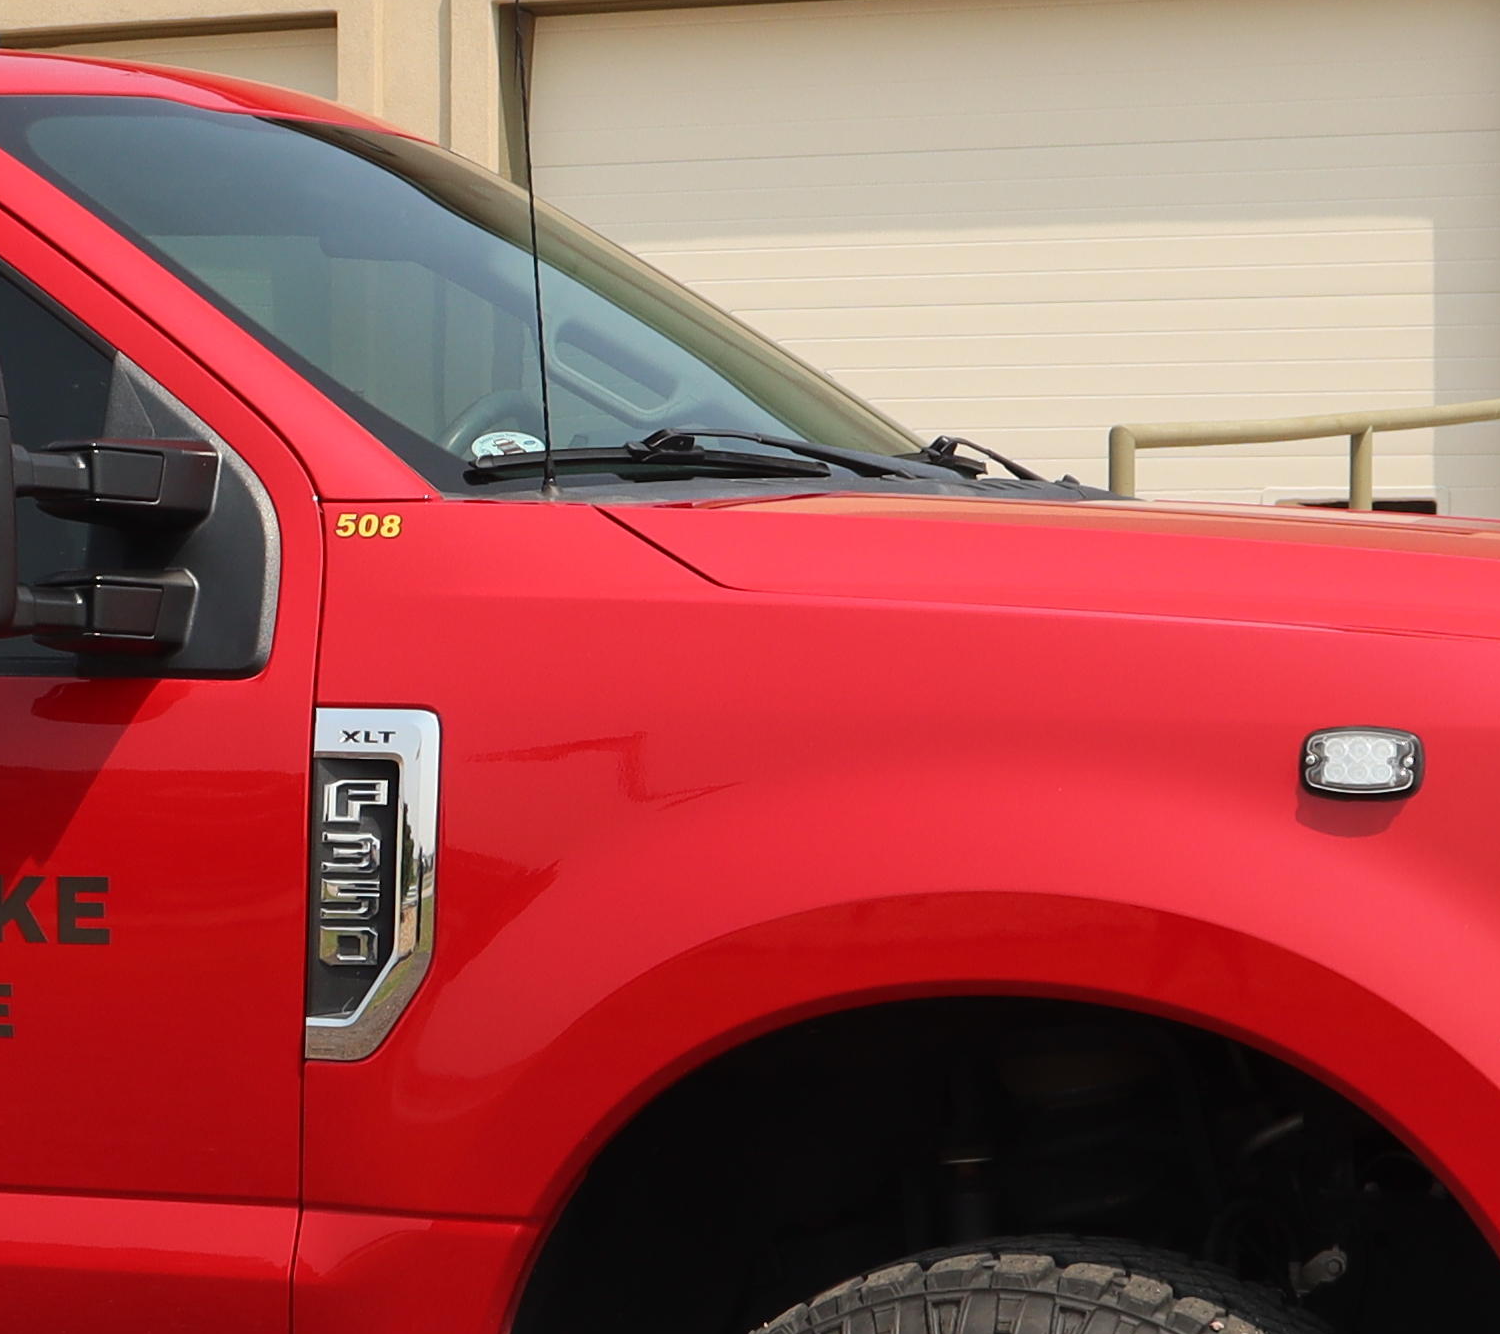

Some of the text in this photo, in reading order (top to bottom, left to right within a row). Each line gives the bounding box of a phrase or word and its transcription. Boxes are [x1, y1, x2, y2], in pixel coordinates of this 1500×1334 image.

[335, 512, 402, 539] 508
[341, 730, 396, 744] XLT
[318, 778, 389, 966] F350
